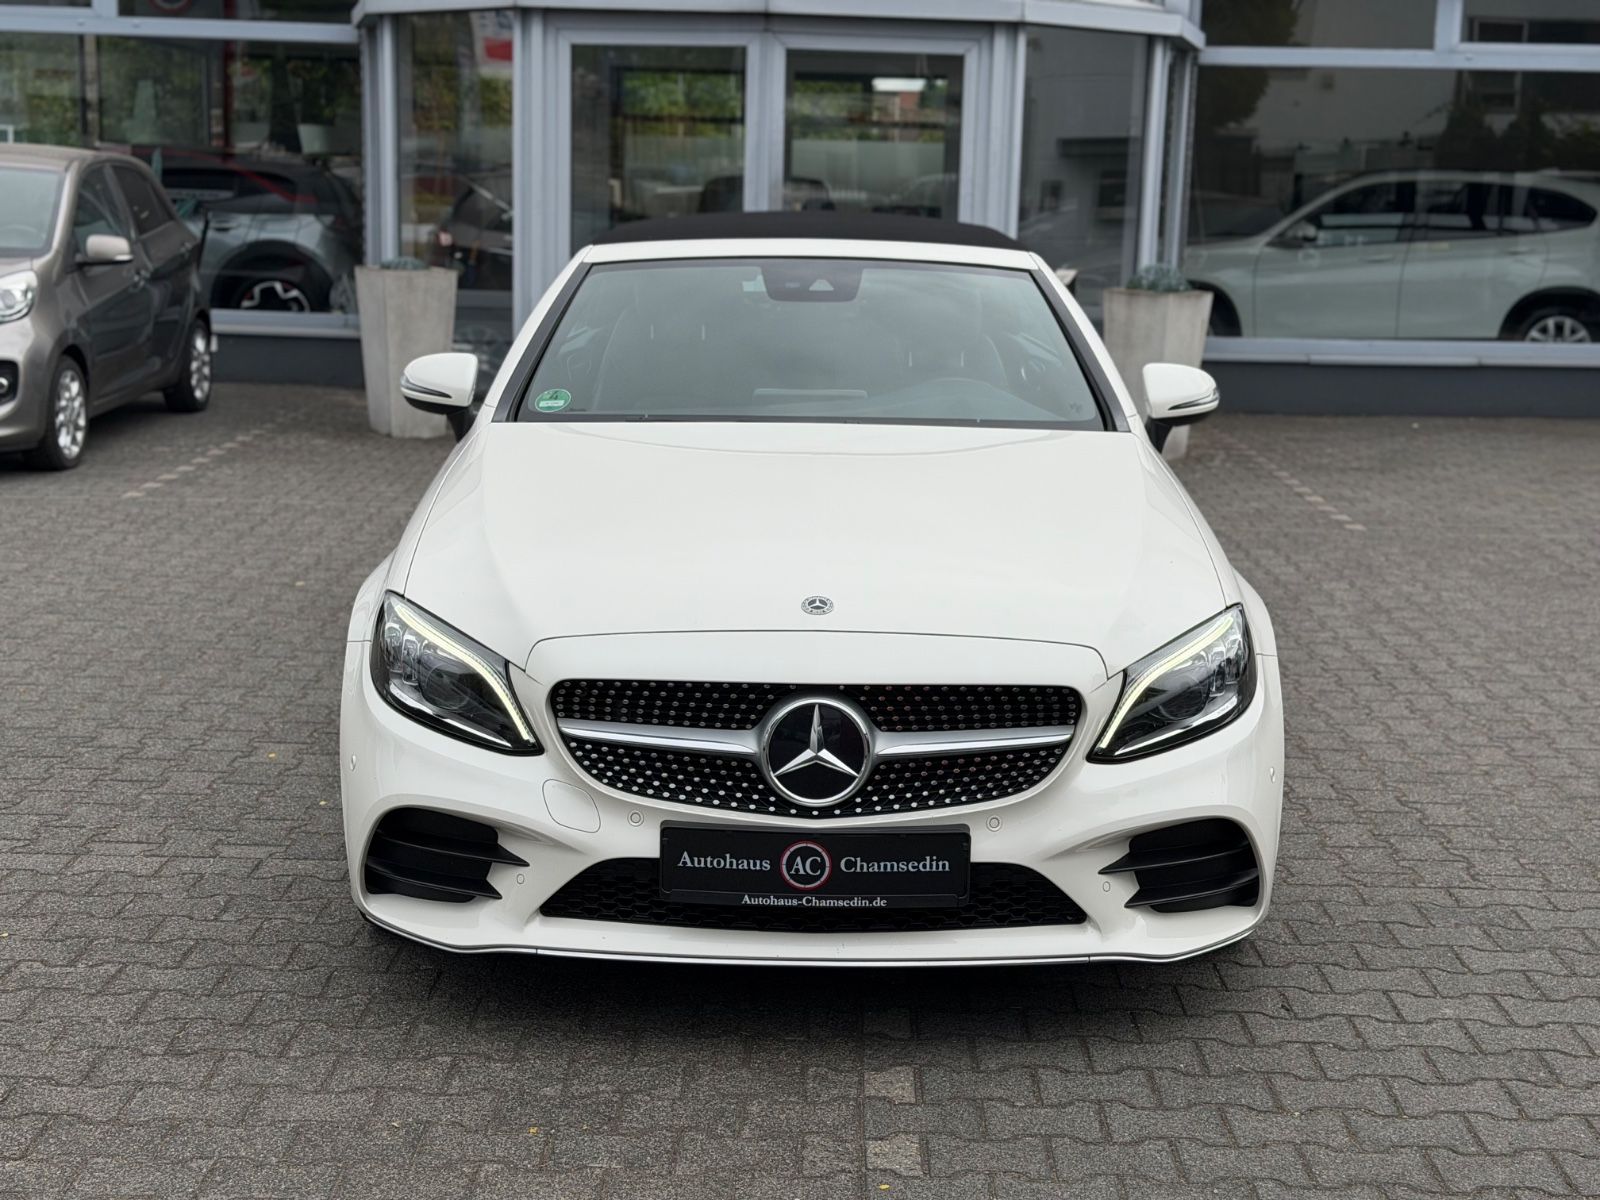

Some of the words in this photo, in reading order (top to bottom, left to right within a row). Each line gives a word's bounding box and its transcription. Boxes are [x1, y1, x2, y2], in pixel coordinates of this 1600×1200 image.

[677, 850, 771, 871] Autohaus
[789, 856, 821, 876] AC
[839, 855, 950, 874] Chamsedin
[741, 894, 888, 908] Autohaus-Chamsedin.de
